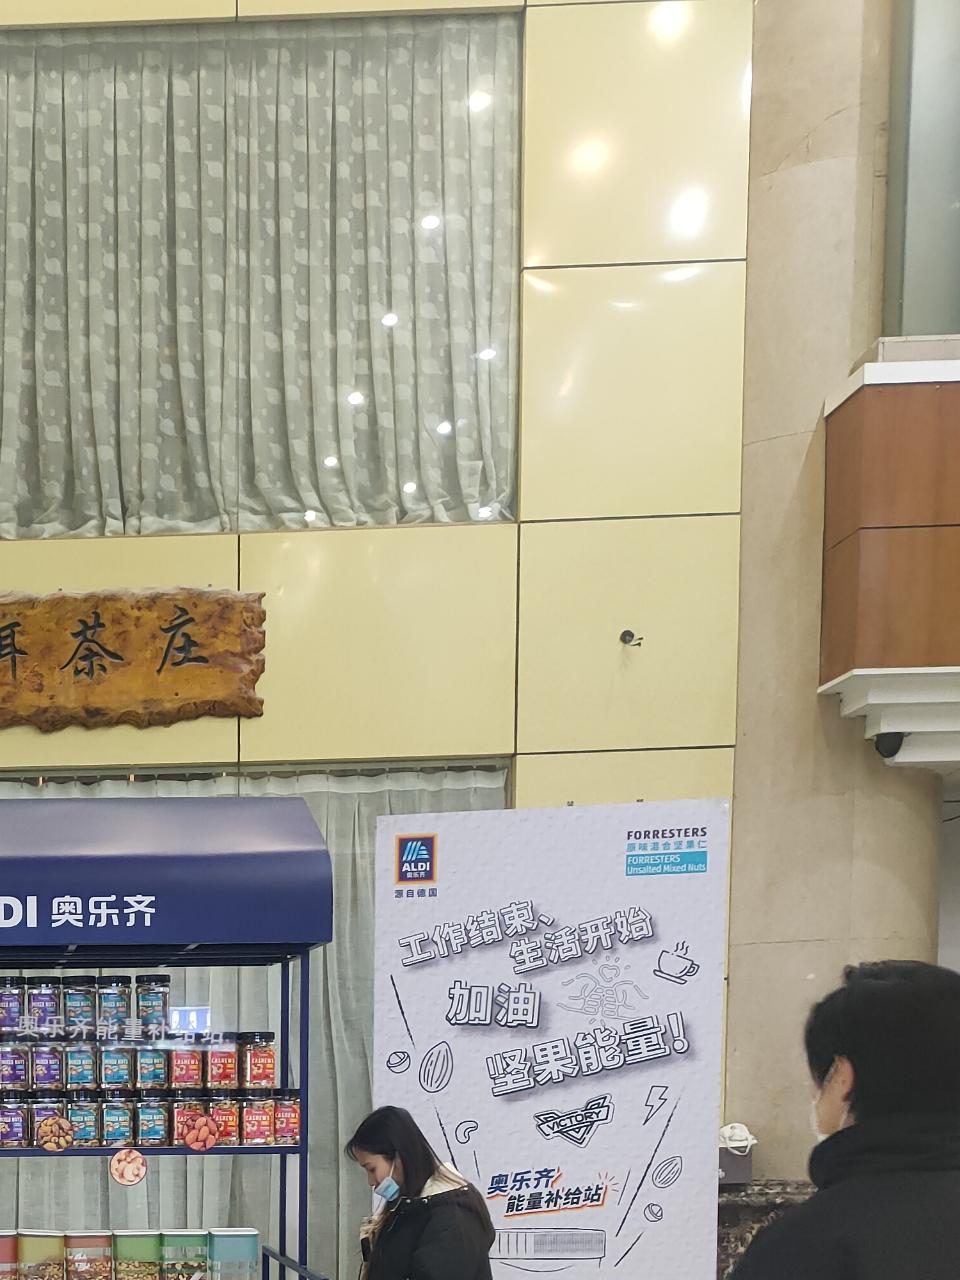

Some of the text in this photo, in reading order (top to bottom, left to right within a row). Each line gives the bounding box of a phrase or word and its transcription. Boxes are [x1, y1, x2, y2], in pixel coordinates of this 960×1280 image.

[627, 827, 707, 840] FORRESTERS
[402, 862, 430, 872] ALDI
[627, 855, 681, 865] FORRESTERS
[627, 863, 706, 875] Unsalted Mixed Nuts
[51, 895, 156, 928] 奥乐齐
[509, 906, 655, 975] 生活开始
[446, 981, 541, 1028] 加油
[486, 1012, 690, 1096] 坚果能量！
[547, 1110, 602, 1131] VICTORY
[487, 1168, 556, 1195] 奥乐齐
[506, 1184, 603, 1213] 能量补给站
